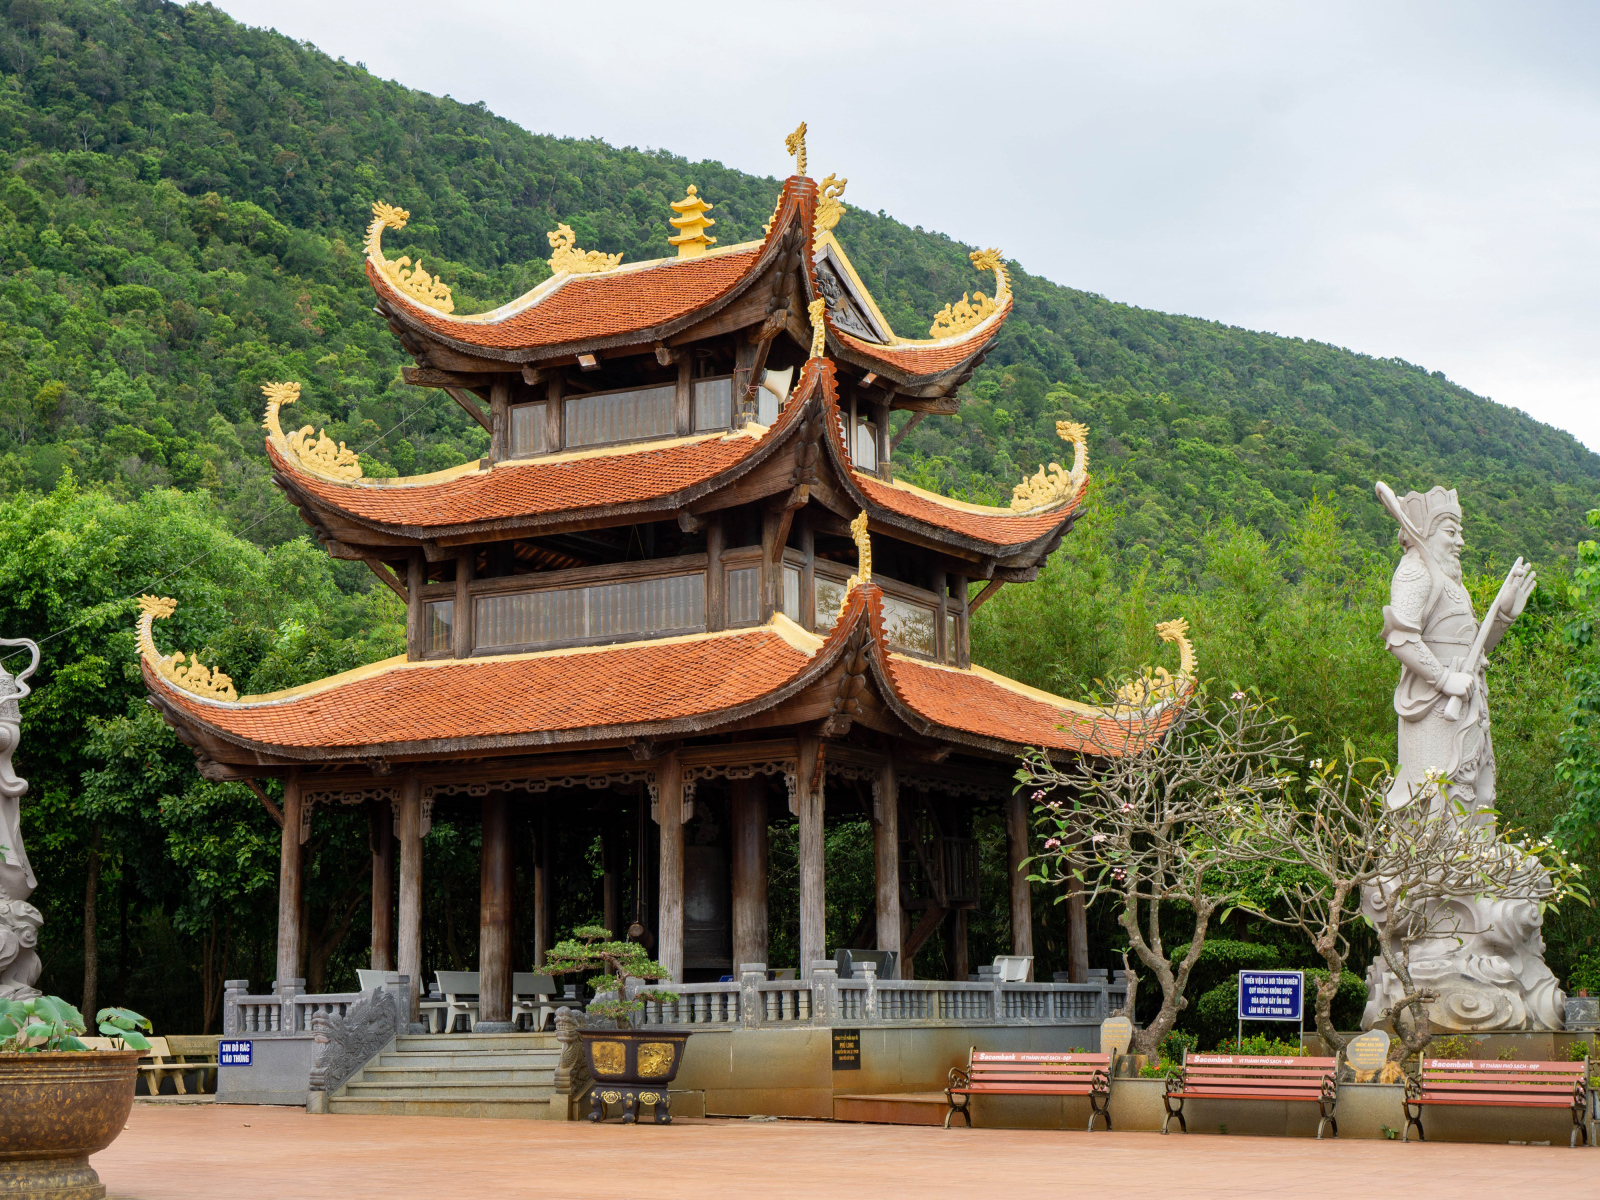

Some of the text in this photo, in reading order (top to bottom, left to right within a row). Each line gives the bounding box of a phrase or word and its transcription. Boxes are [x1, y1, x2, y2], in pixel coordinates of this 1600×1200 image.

[222, 1044, 231, 1052] XIN
[232, 1042, 238, 1052] BỎ
[240, 1042, 250, 1052] RÁC
[222, 1053, 249, 1063] VÀO THÙNG
[1432, 1060, 1473, 1068] Sacombank
